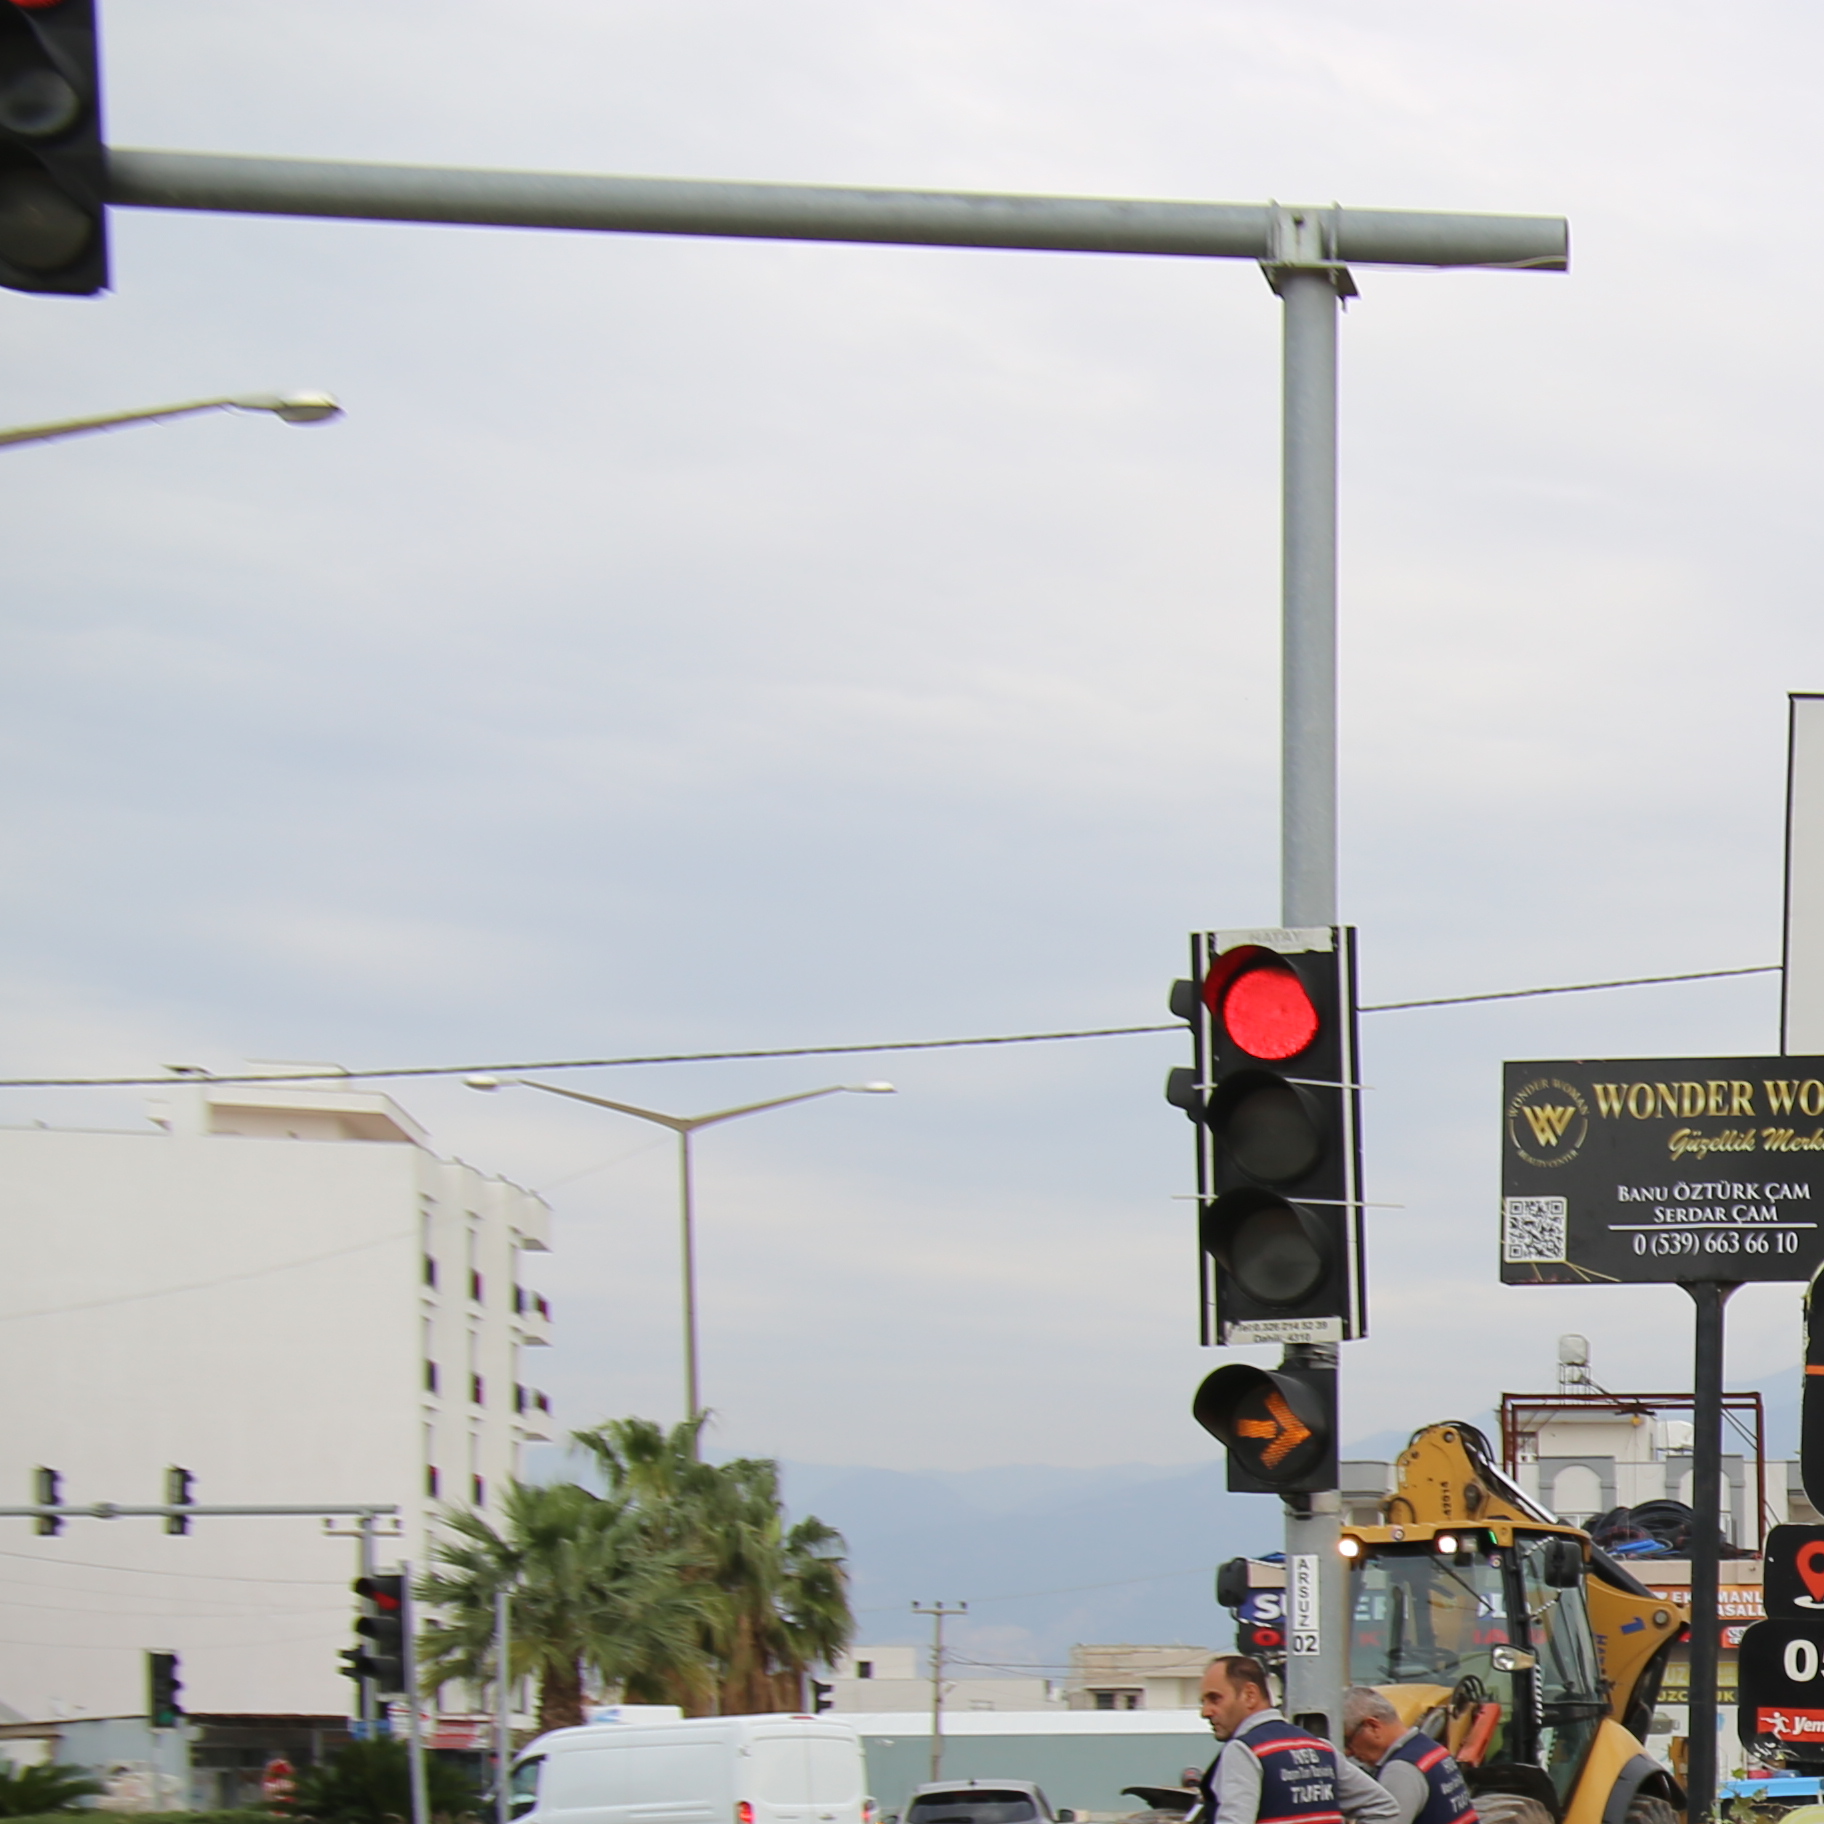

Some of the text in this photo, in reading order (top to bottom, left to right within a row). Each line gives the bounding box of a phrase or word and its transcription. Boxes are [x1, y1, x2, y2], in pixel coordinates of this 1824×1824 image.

[1592, 1083, 1756, 1121] WONDER
[1668, 1129, 1757, 1160] Güzellik
[1673, 1181, 1761, 1201] ÖZTÜRK
[1764, 1182, 1810, 1204] ÇAM
[1732, 1205, 1779, 1225] ÇAM
[1633, 1233, 1798, 1259] 0 (539) 663 66 10
[1298, 1558, 1311, 1627] ARSUZ
[1292, 1635, 1317, 1653] 02
